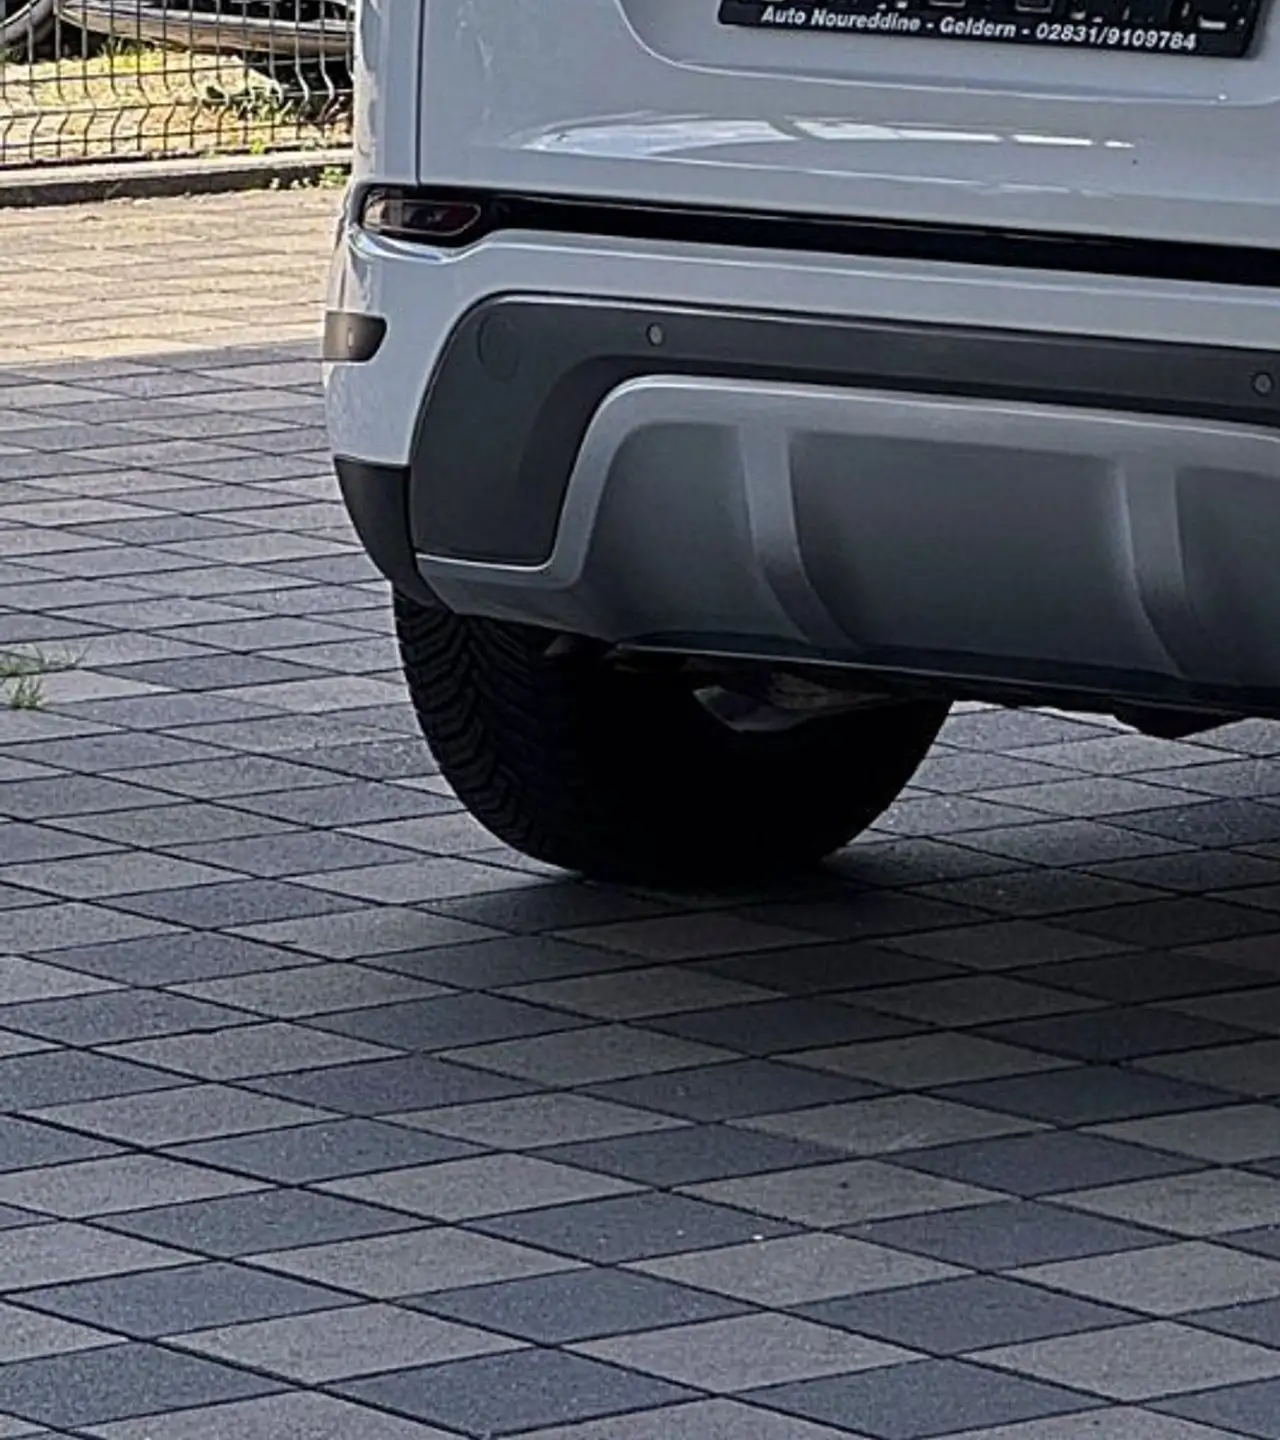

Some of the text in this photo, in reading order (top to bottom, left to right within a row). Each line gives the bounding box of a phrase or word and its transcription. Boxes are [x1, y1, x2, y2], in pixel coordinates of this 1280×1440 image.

[761, 5, 806, 25] Auto
[811, 7, 921, 32] Noureddine
[939, 16, 1016, 38] Geldern
[1035, 22, 1198, 51] 02831/9109784
